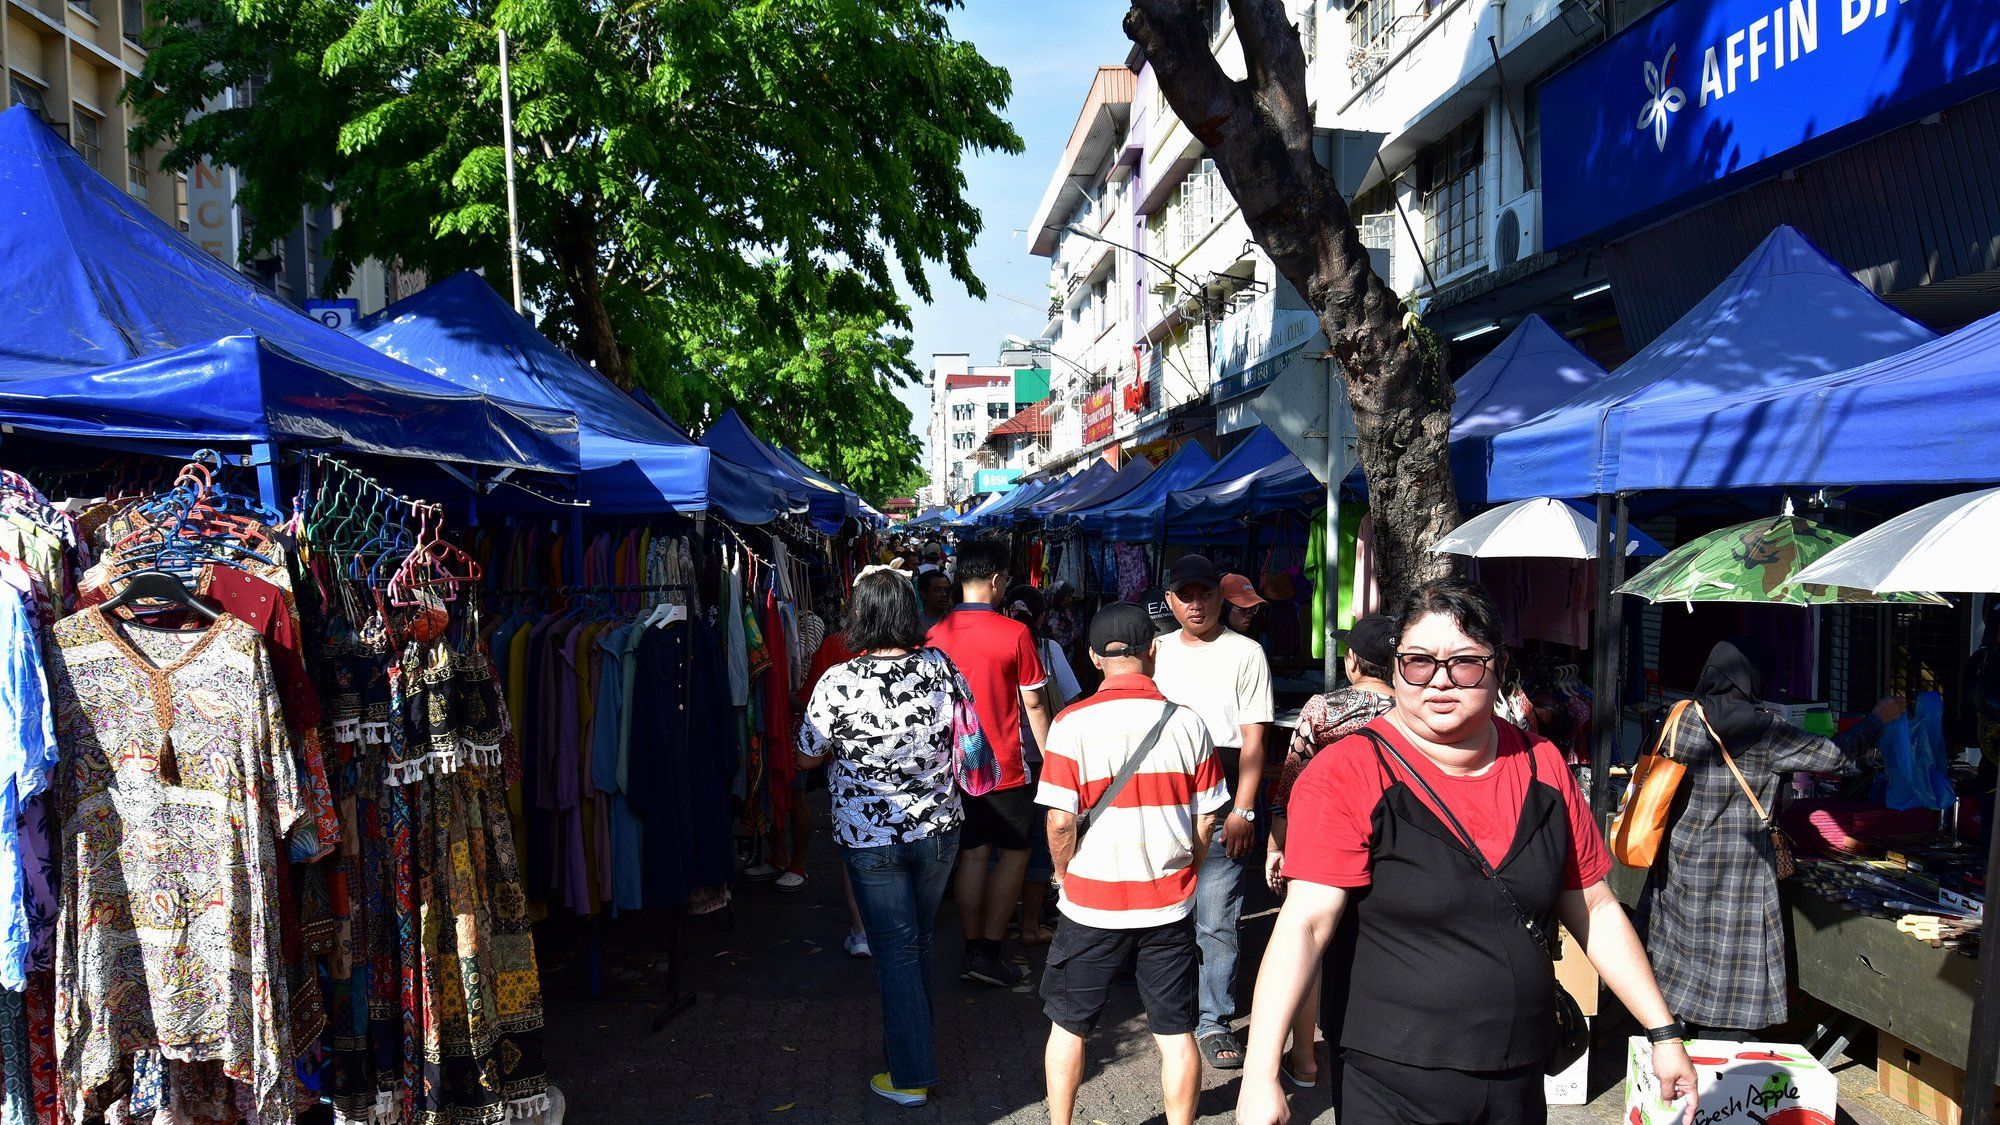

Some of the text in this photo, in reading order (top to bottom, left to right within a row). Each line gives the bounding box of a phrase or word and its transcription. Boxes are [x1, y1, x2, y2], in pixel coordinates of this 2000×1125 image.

[1699, 0, 1910, 108] AFFIN B
[1287, 318, 1306, 341] CLINIC
[990, 474, 1008, 486] BSN
[1147, 600, 1172, 615] EA
[1694, 1083, 1801, 1125] Fresh Apple
